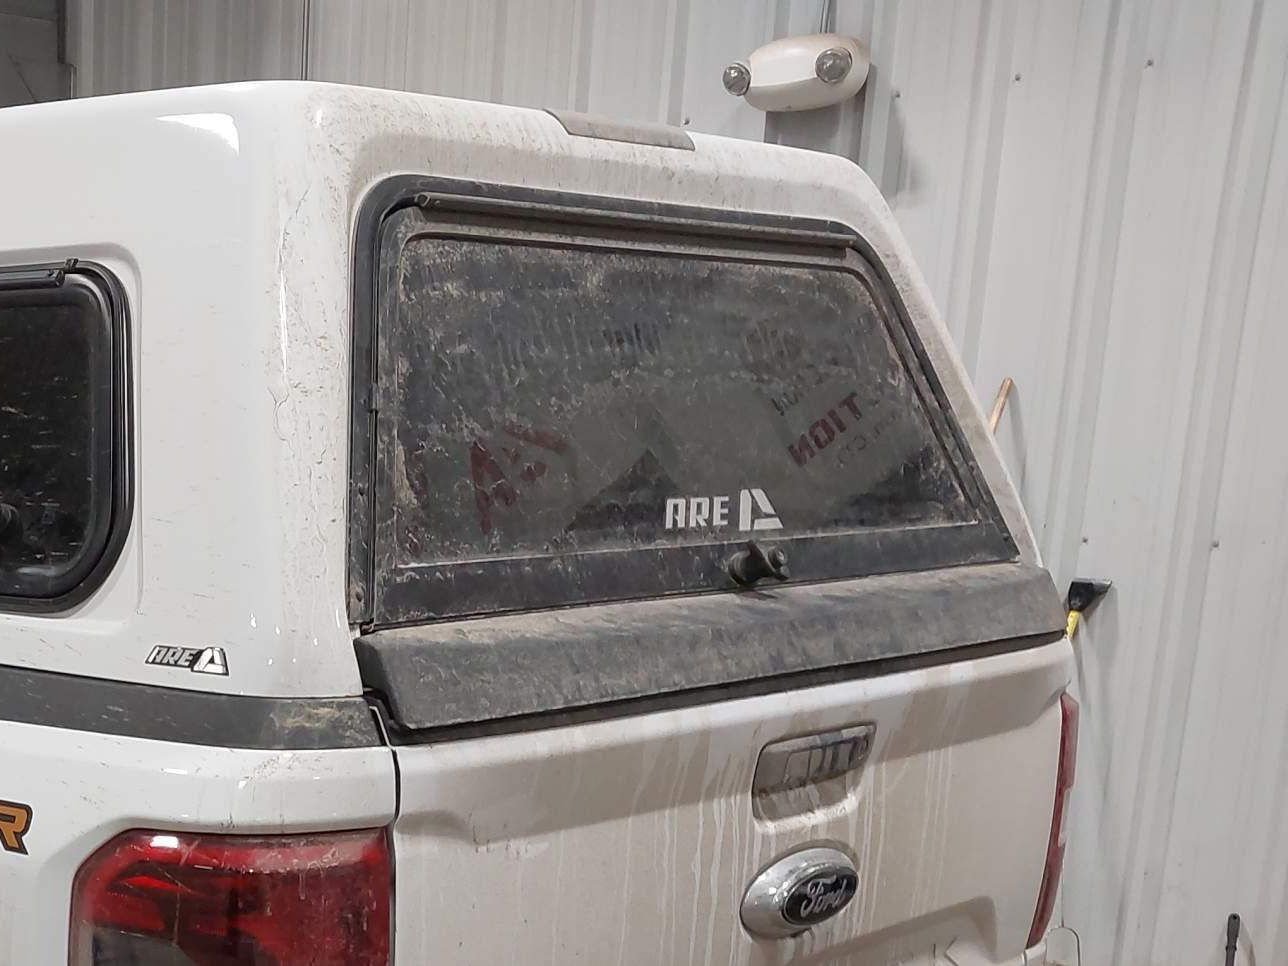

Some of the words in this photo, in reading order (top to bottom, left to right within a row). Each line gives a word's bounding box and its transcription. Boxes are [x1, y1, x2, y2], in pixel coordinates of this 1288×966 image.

[665, 496, 729, 529] ARE
[145, 646, 200, 667] ARE
[800, 874, 848, 918] Ford
